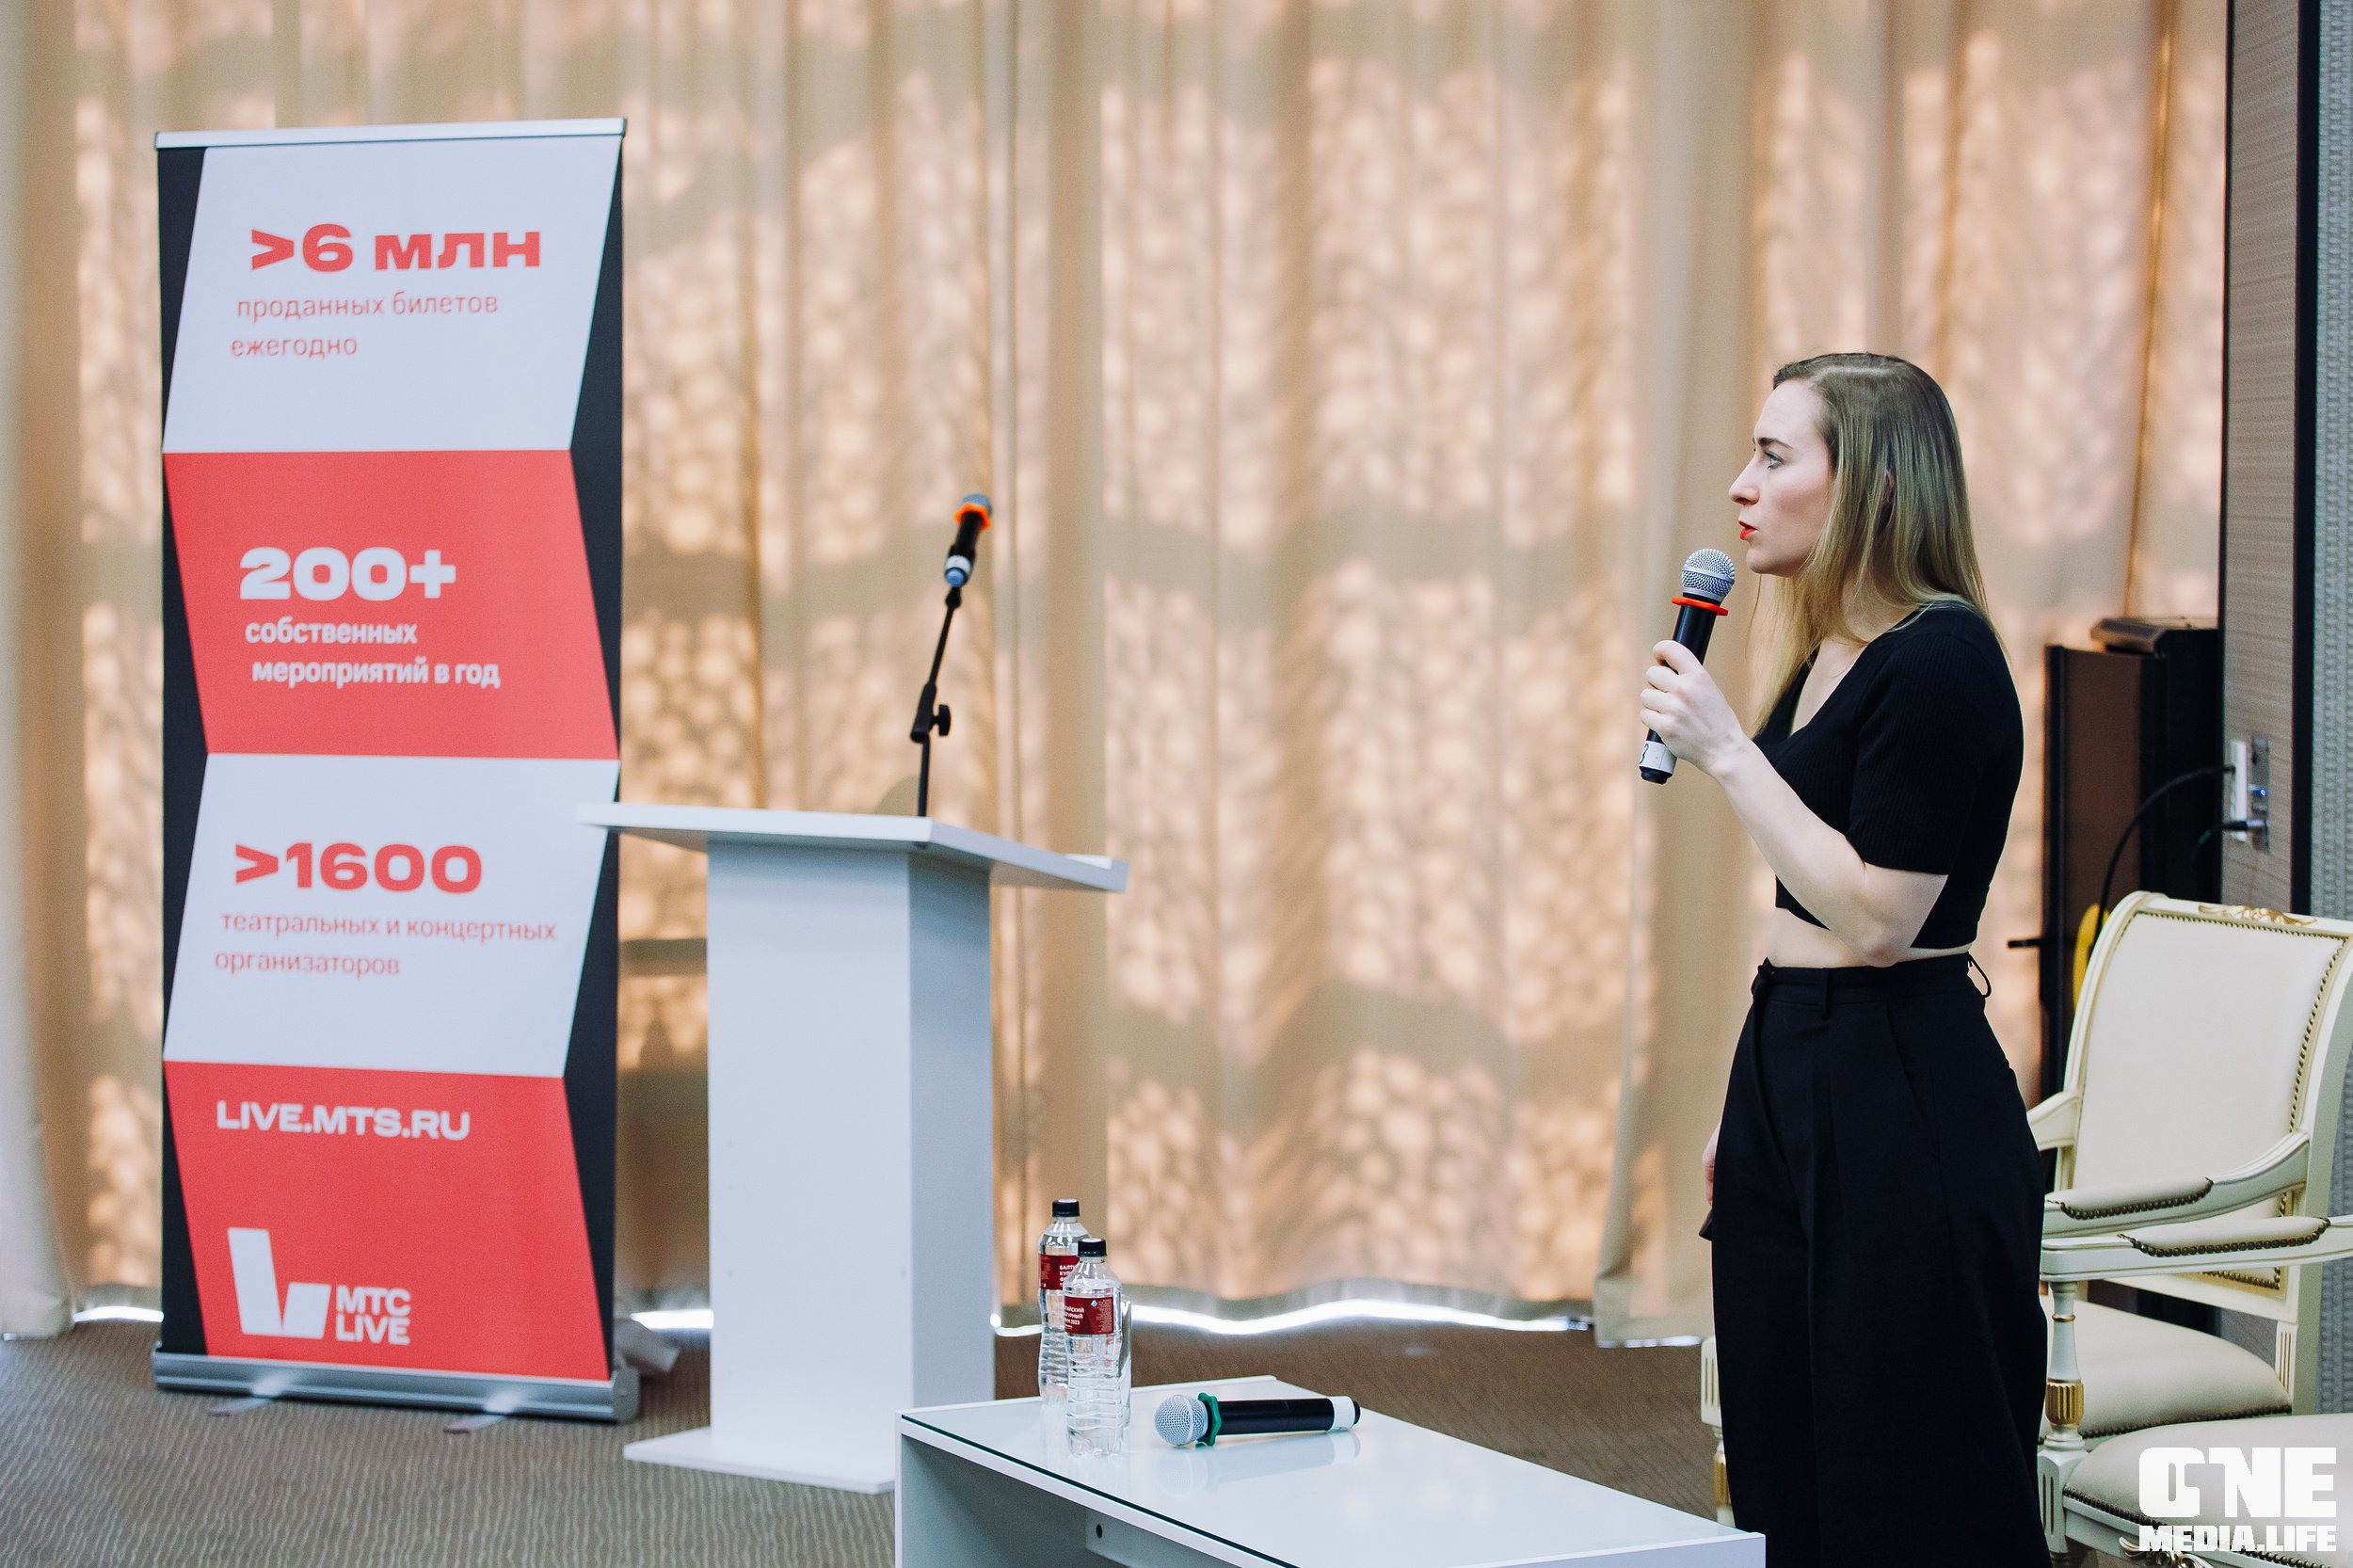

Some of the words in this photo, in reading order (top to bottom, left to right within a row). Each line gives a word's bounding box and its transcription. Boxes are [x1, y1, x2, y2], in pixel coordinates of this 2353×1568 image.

[251, 224, 354, 273] >6
[237, 295, 384, 322] проданных
[392, 291, 499, 317] билетов
[232, 336, 359, 360] ежегодно
[240, 547, 457, 601] 200+
[246, 616, 419, 645] собственных
[252, 656, 429, 689] мероприятий
[435, 664, 450, 684] в
[456, 664, 502, 689] год
[235, 842, 482, 894] >1600
[222, 914, 379, 938] театральных
[387, 920, 401, 936] и
[407, 921, 557, 944] концертных
[216, 952, 401, 978] организаторов
[217, 1101, 471, 1141] LIVE.MTS.RU
[336, 1313, 411, 1346] LIVE
